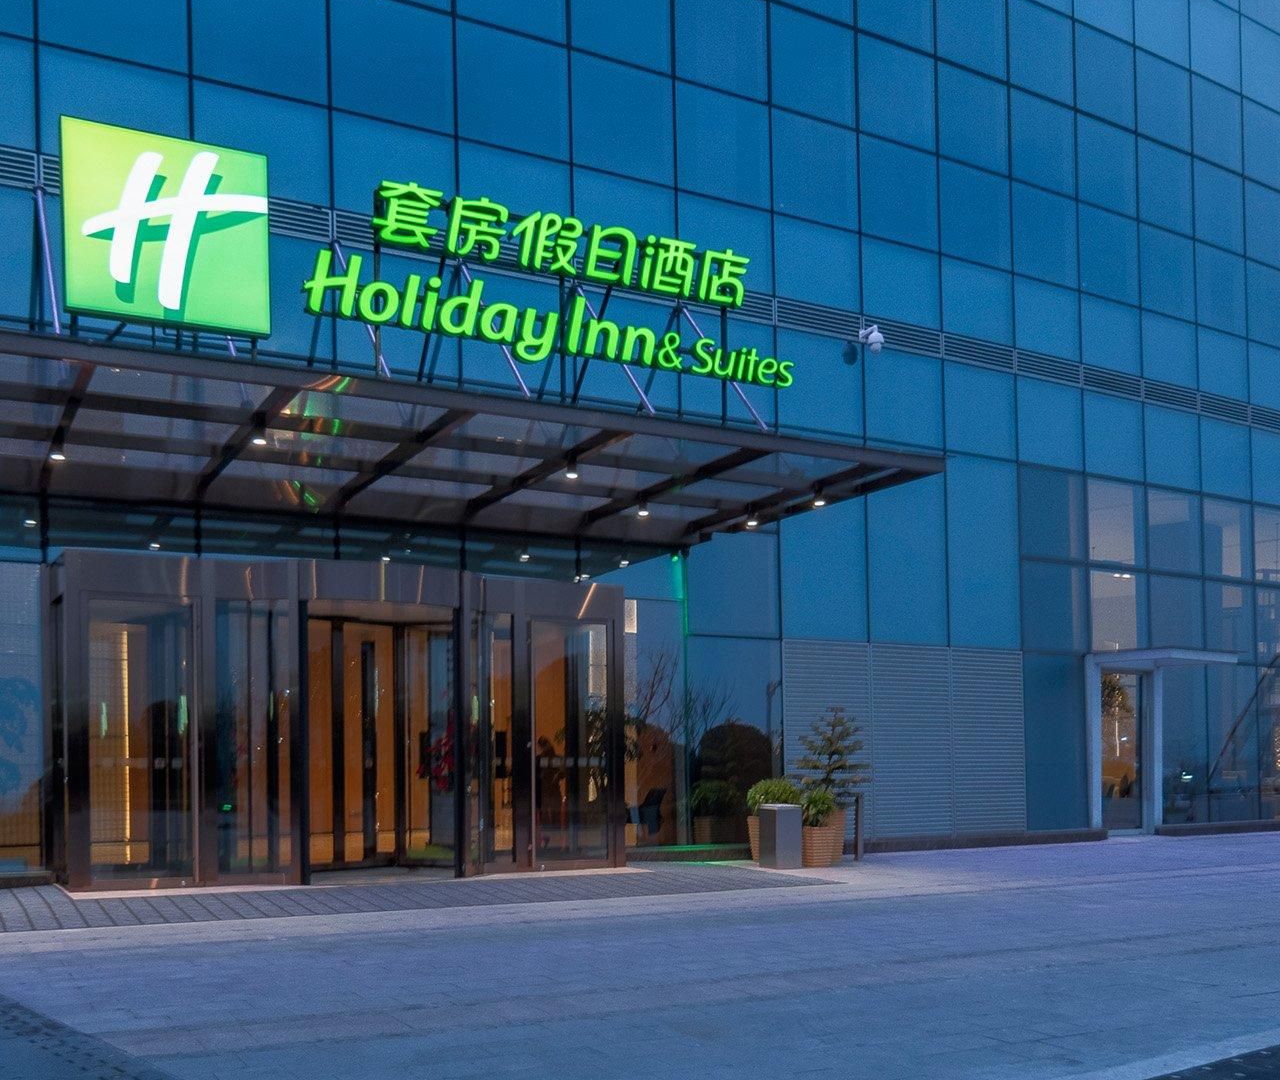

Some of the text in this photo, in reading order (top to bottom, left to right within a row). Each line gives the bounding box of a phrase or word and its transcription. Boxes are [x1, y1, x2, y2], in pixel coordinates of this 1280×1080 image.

[372, 180, 750, 308] 套房假日酒店
[303, 248, 559, 362] Holiday
[567, 295, 657, 367] Inn
[691, 337, 795, 389] Suites
